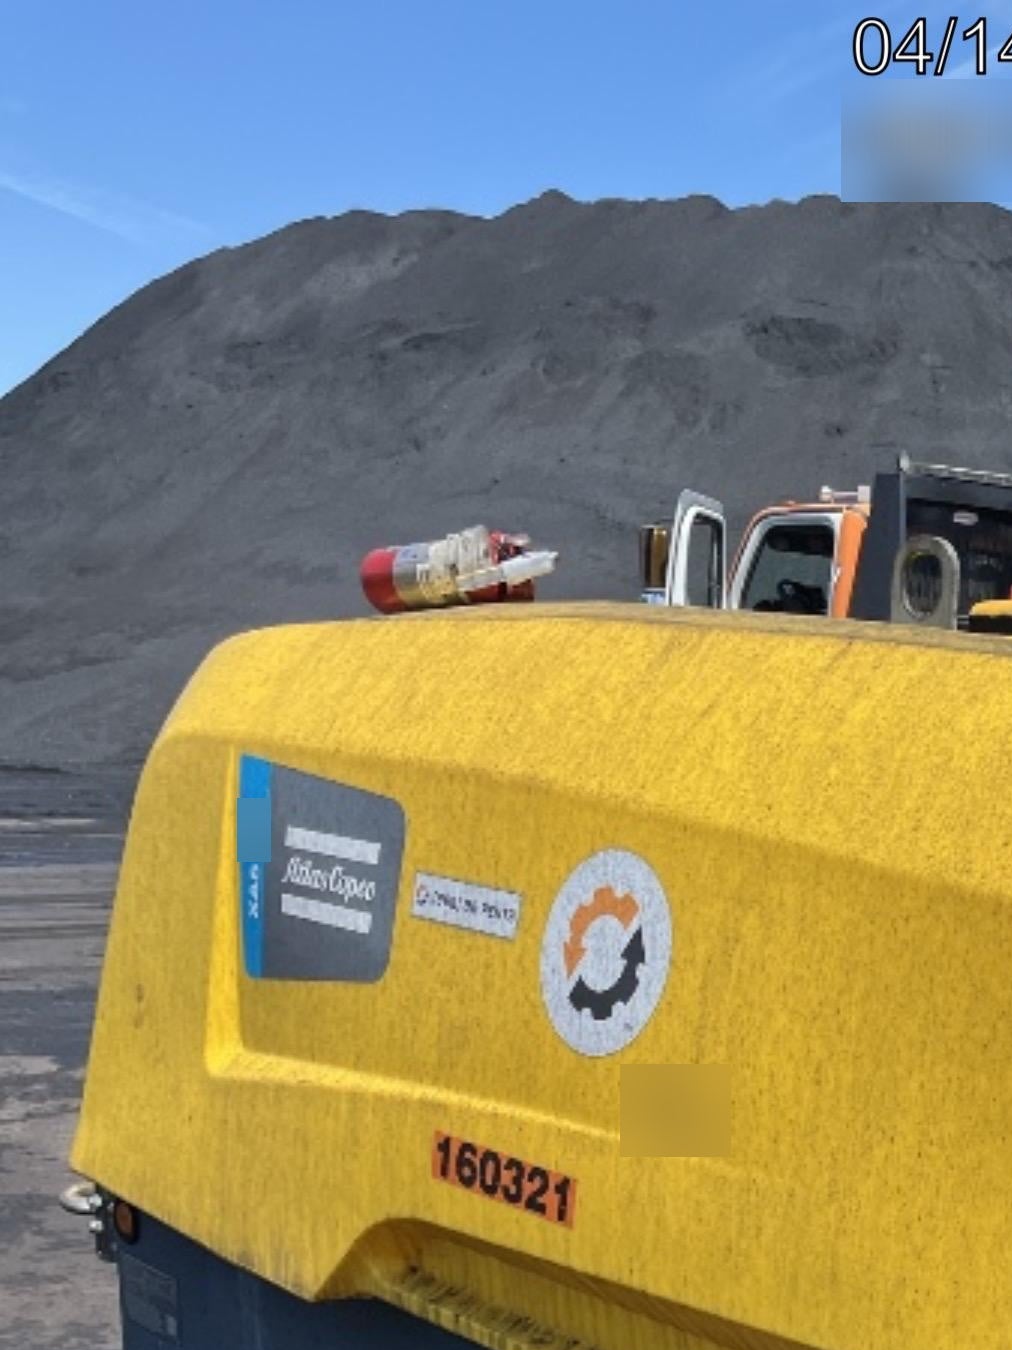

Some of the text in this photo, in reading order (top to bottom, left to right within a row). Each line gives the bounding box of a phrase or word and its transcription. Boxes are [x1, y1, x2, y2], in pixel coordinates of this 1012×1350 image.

[280, 856, 377, 903] Atlas Copco
[437, 1135, 571, 1222] 160321
